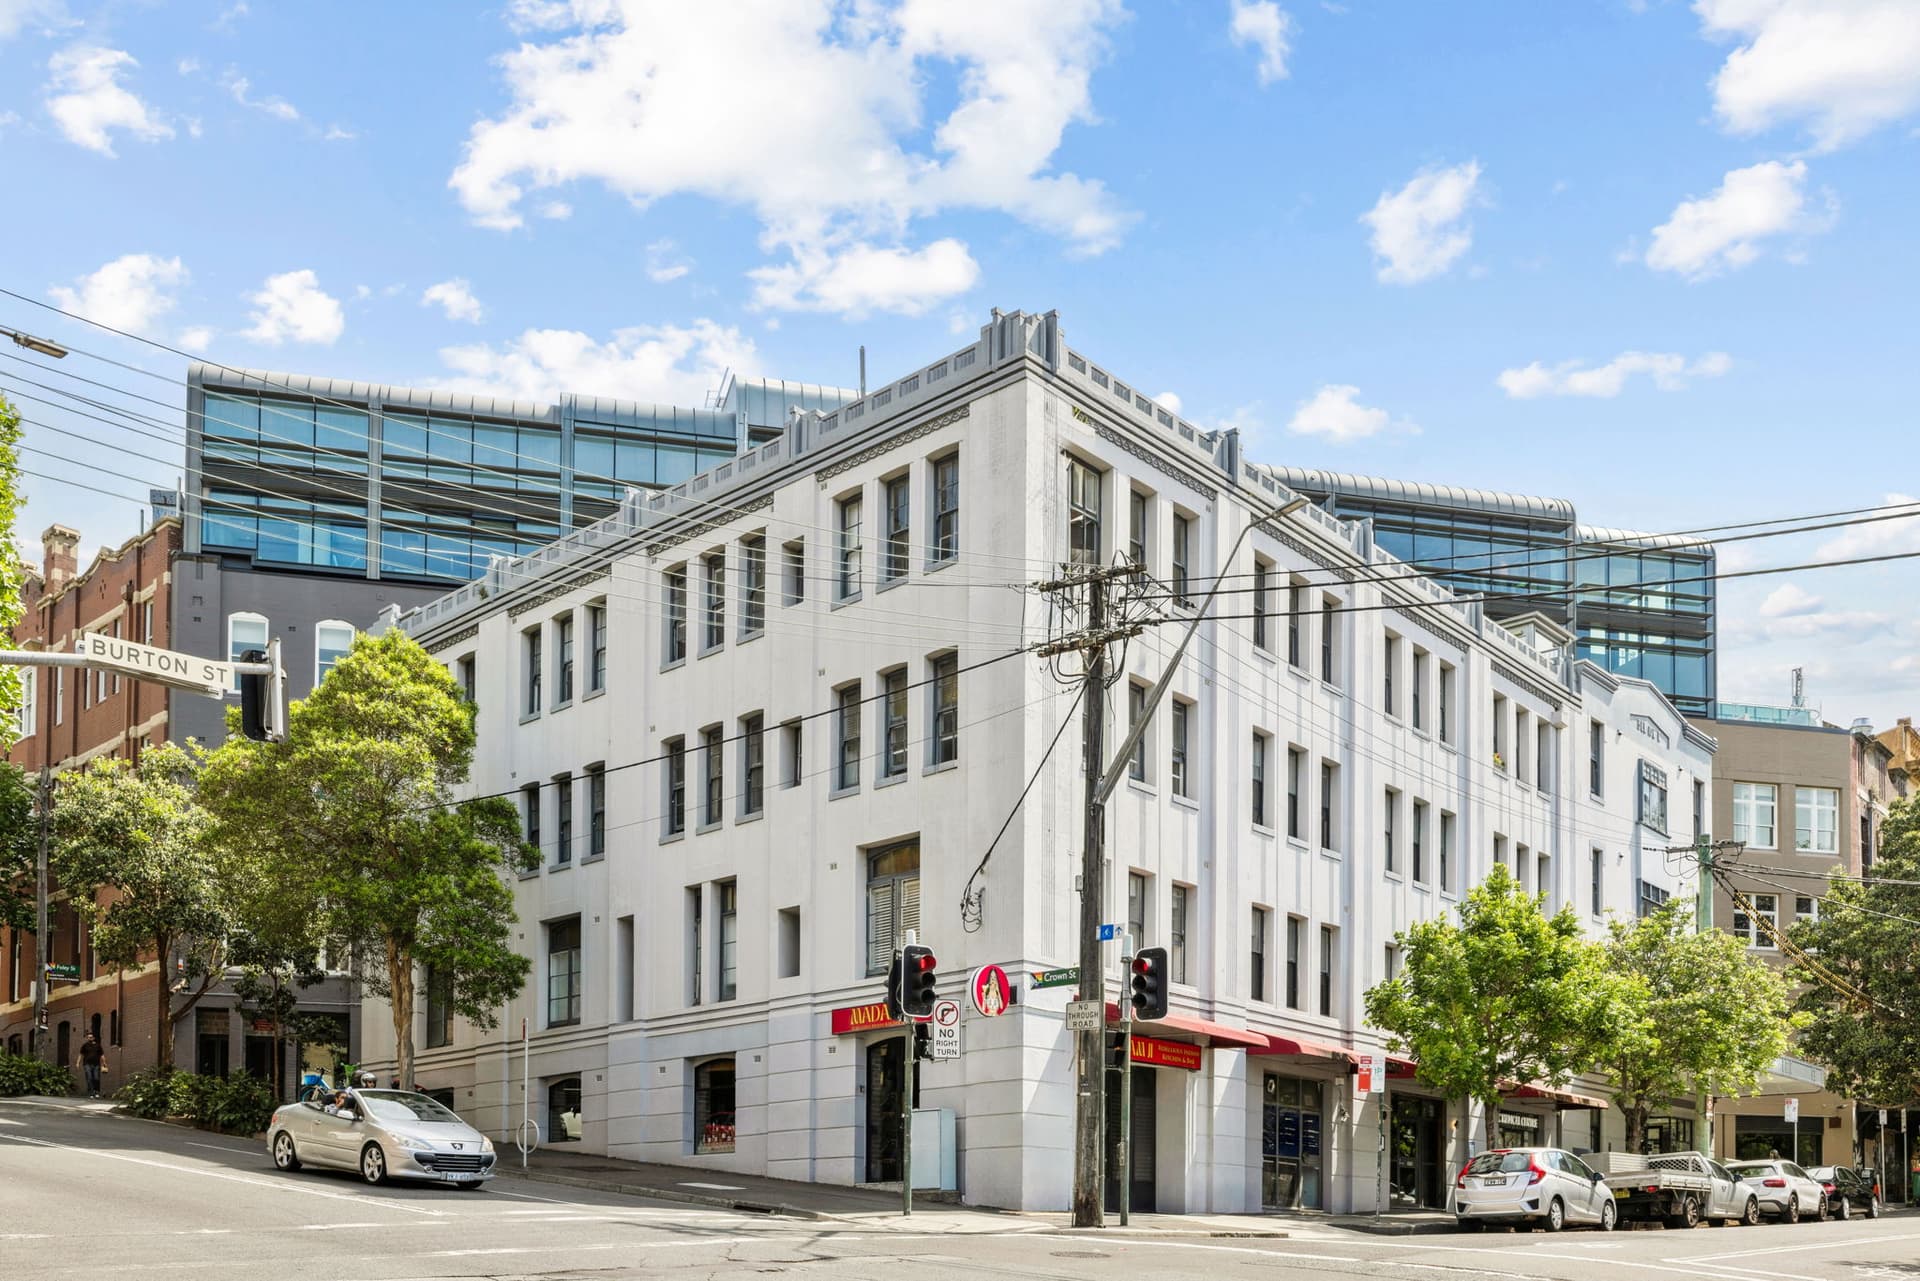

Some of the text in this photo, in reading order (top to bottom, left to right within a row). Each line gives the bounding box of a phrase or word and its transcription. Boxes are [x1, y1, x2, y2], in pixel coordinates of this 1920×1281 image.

[92, 639, 228, 683] BURTON ST
[1043, 969, 1077, 982] Crown St
[1078, 1003, 1089, 1011] NO
[850, 1003, 892, 1025] MADA
[1068, 1011, 1099, 1020] THROUGH
[1072, 1020, 1094, 1028] ROAD
[938, 1028, 955, 1039] NO
[935, 1040, 958, 1048] RIGHT
[937, 1048, 957, 1056] TURN
